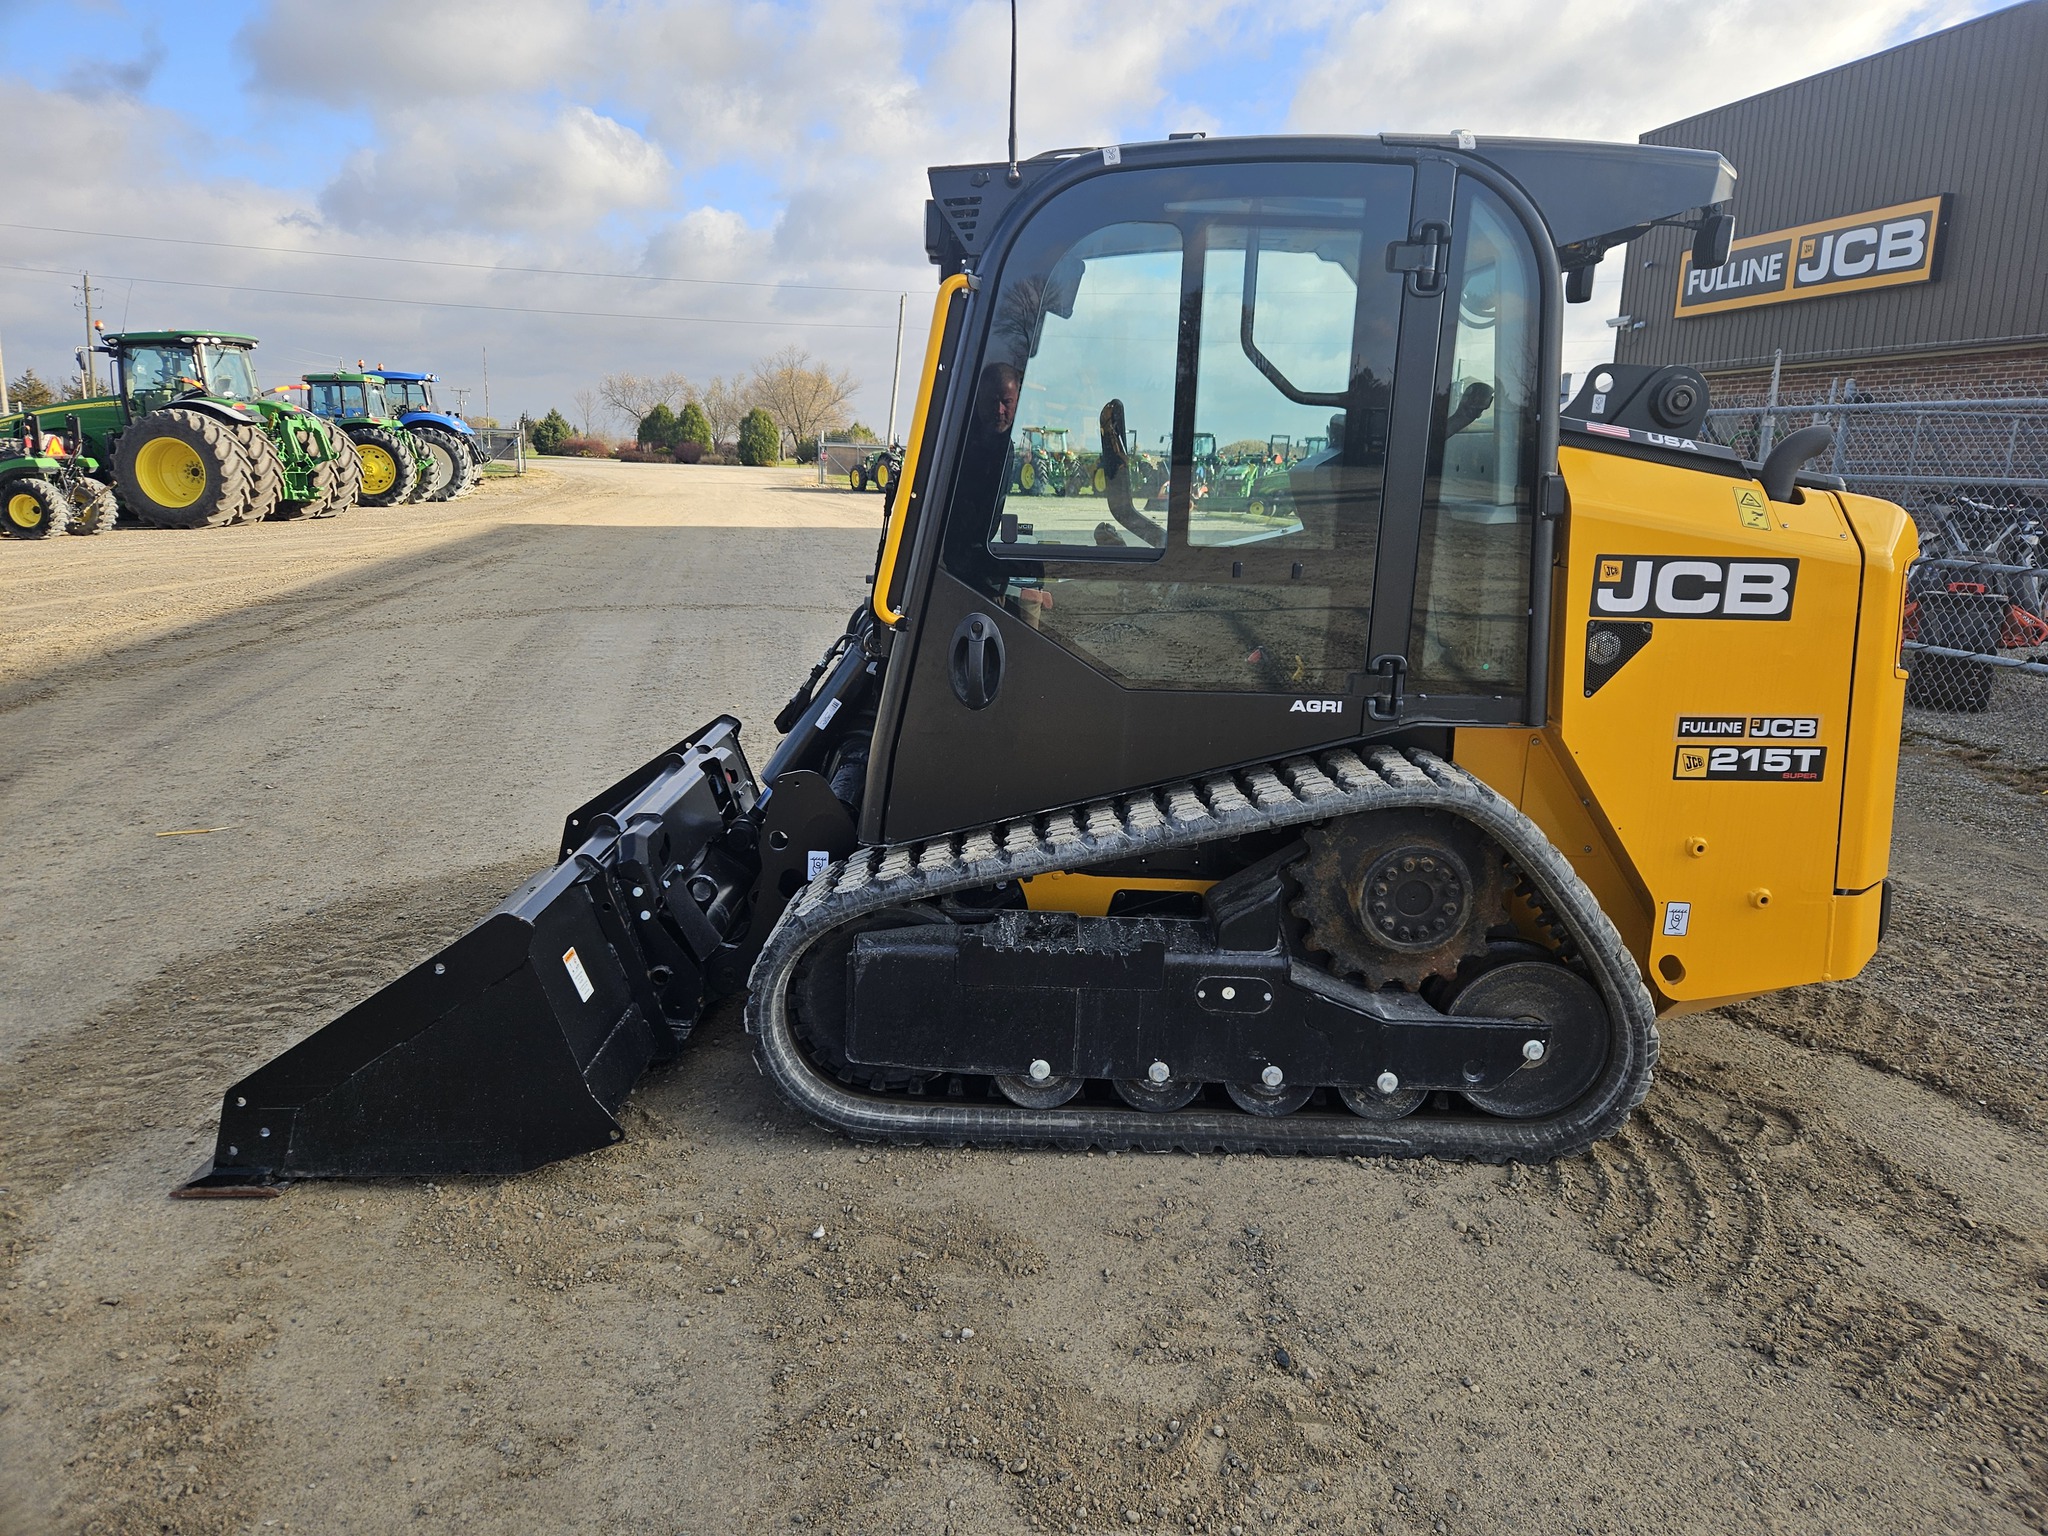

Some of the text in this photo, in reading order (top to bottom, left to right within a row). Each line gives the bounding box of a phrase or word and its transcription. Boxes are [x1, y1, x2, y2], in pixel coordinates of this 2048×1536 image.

[1687, 218, 1926, 296] FULLINE JCB
[1647, 432, 1699, 450] USA
[1605, 565, 1619, 576] JCB
[1596, 560, 1791, 615] JCB
[1289, 699, 1343, 713] AGRI
[1681, 719, 1816, 737] FULLINE JCB
[1685, 755, 1703, 770] JCB
[1709, 747, 1821, 772] 215T
